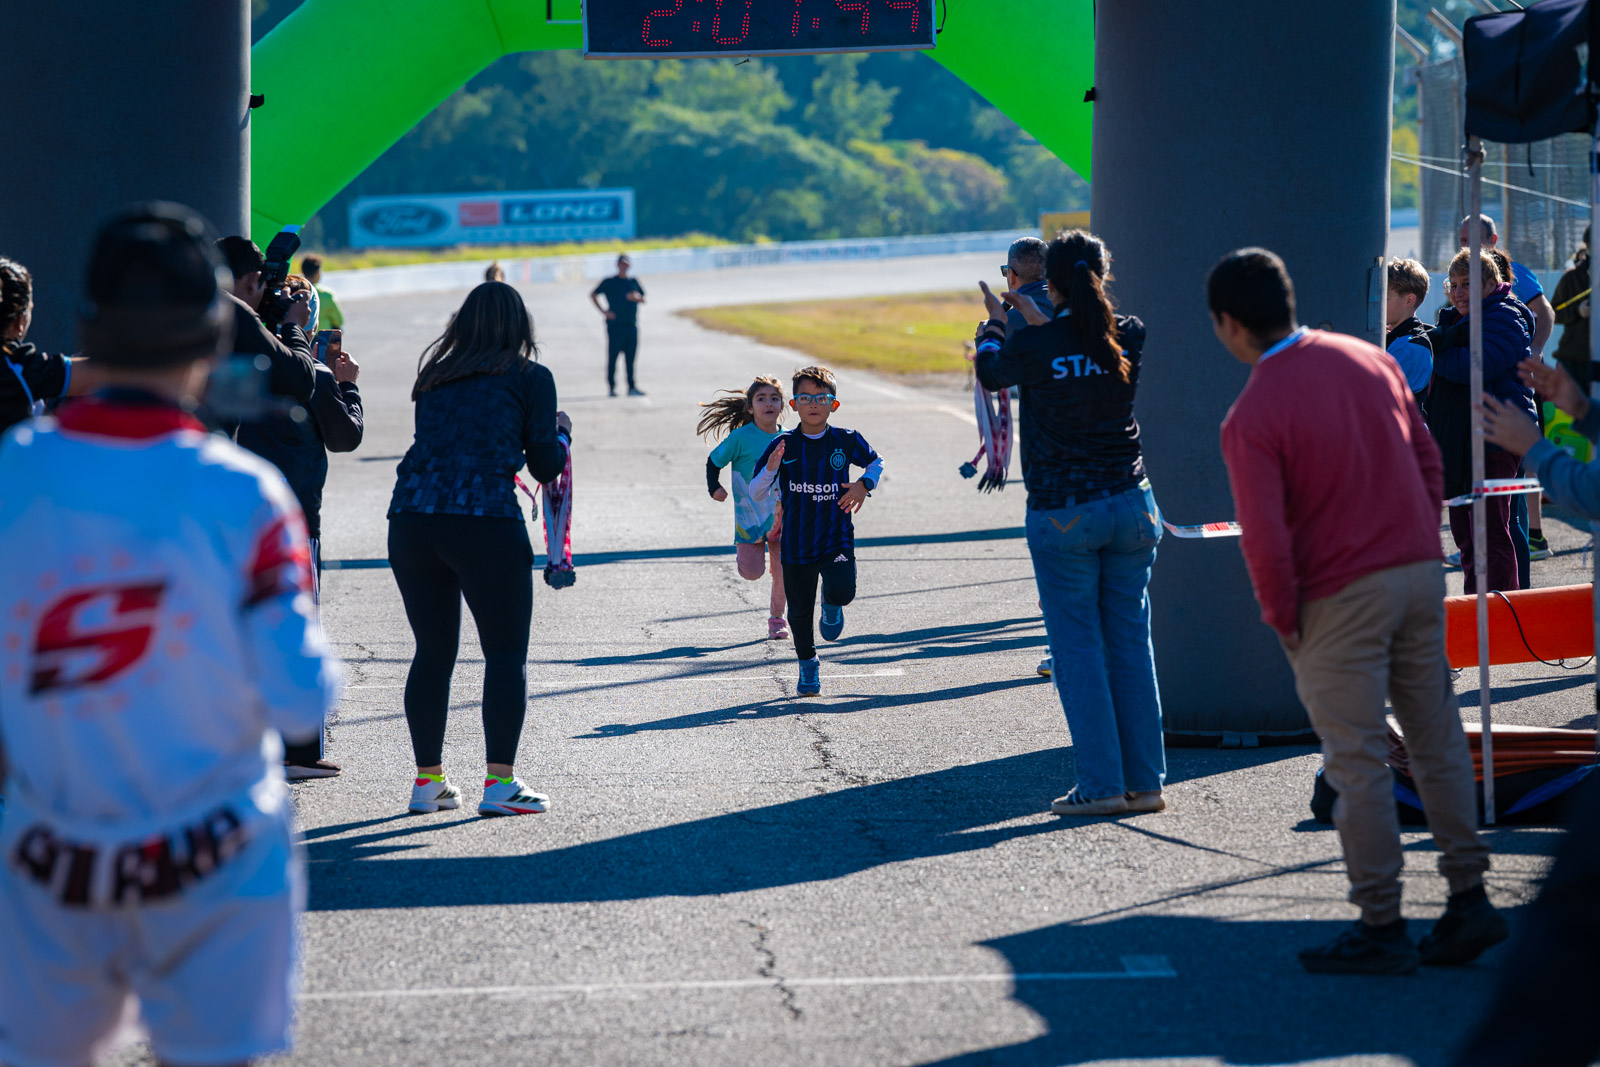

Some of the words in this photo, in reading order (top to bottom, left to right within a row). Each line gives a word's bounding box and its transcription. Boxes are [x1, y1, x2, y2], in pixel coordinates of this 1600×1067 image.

[511, 202, 612, 221] LONG
[789, 480, 839, 493] betsson
[812, 493, 838, 502] sport.
